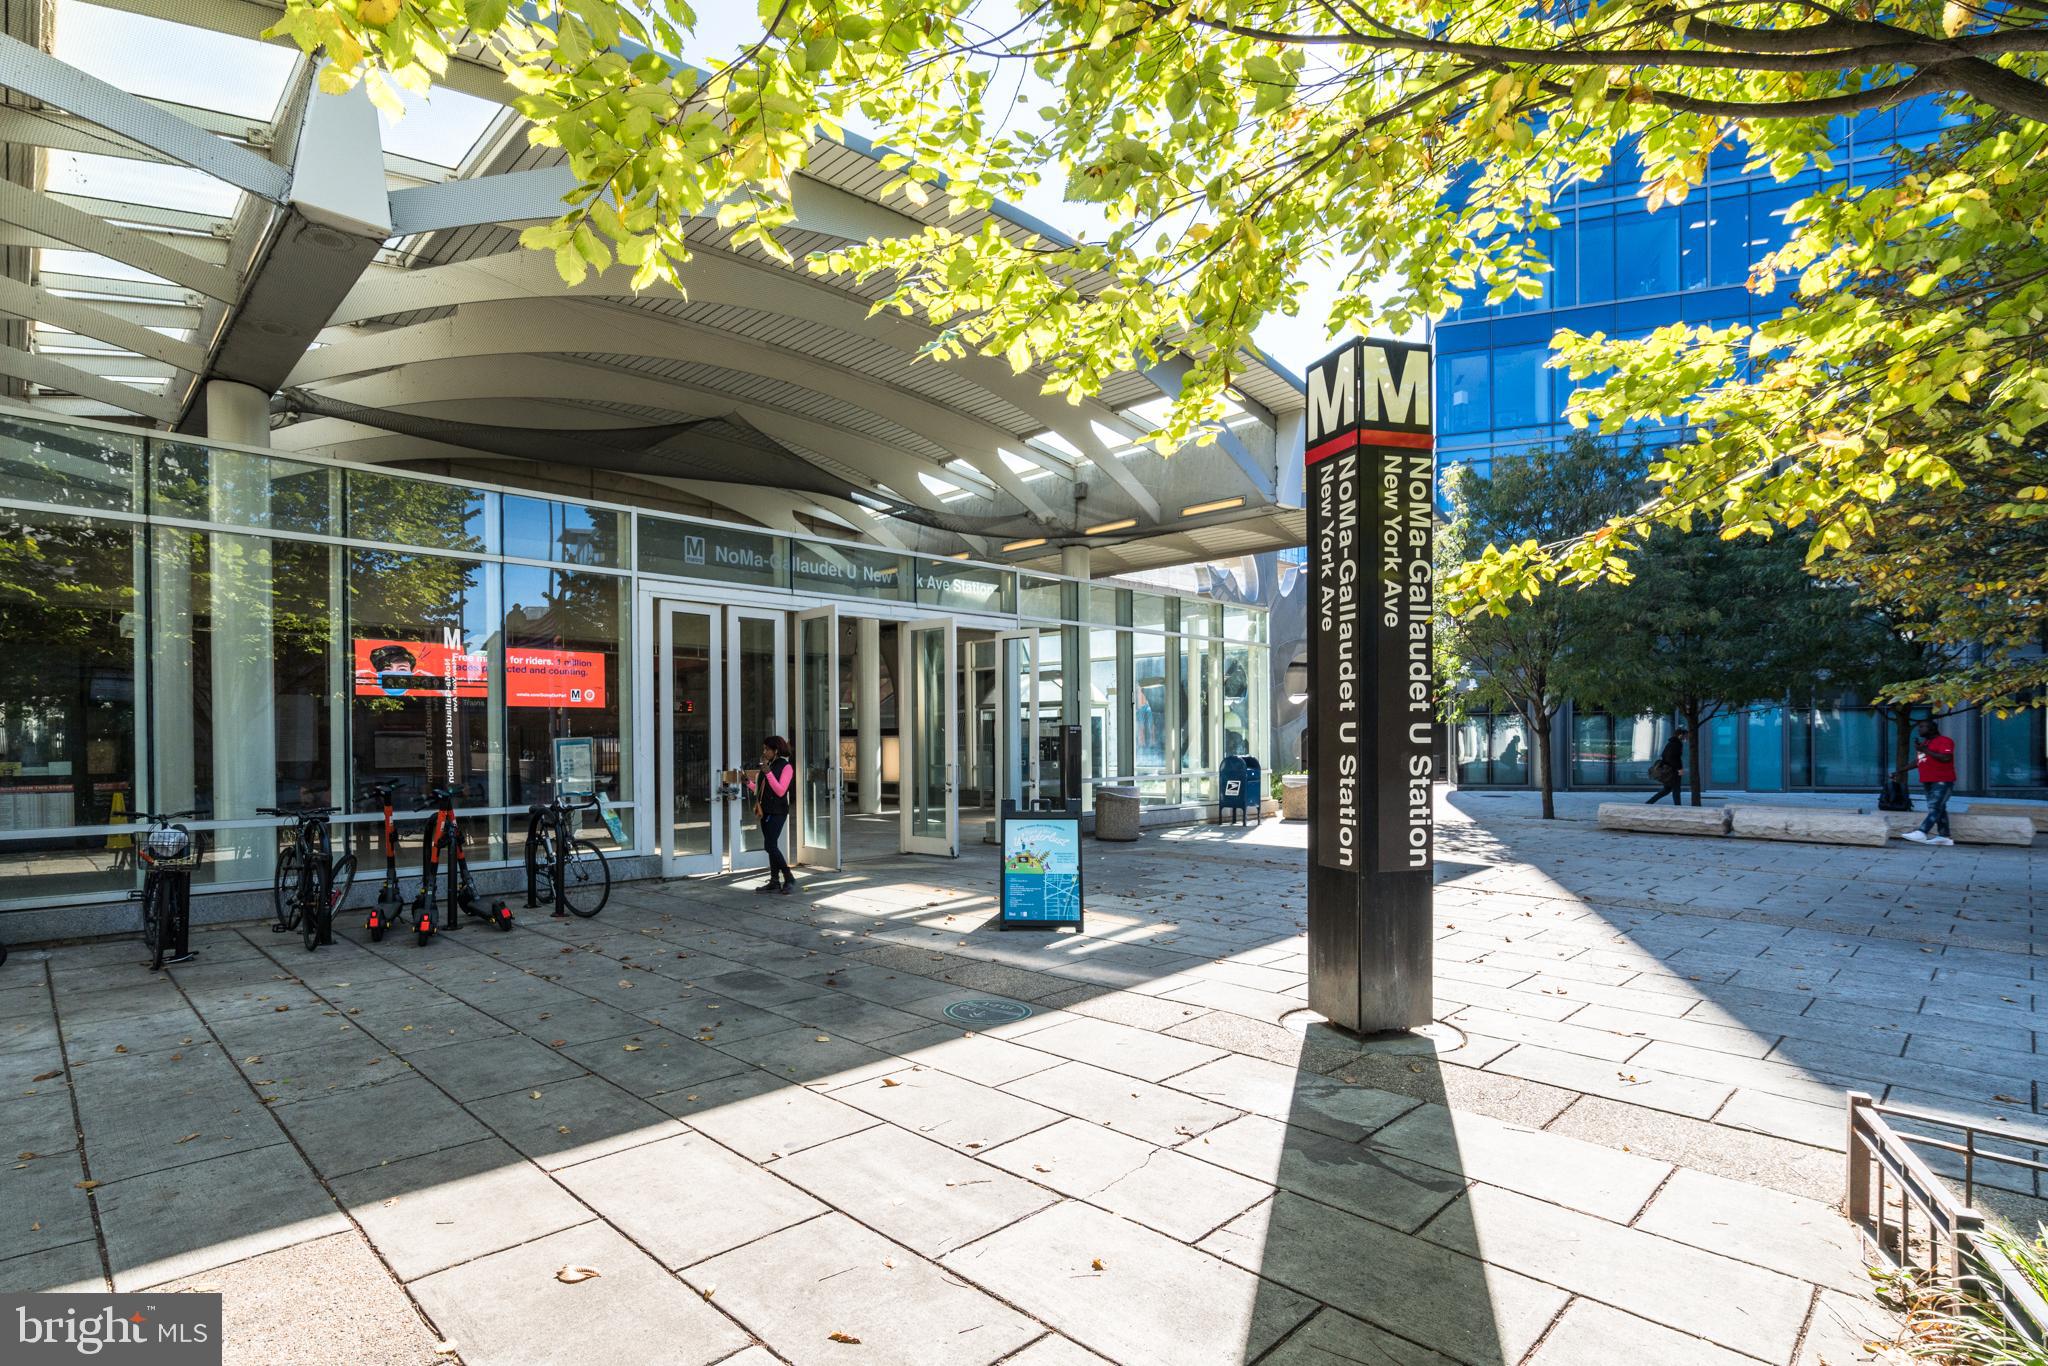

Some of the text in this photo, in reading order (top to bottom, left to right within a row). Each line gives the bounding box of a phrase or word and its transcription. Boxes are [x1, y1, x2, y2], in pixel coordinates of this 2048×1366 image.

[1308, 346, 1355, 443] M
[1363, 345, 1430, 426] M
[687, 536, 703, 557] M
[847, 564, 857, 580] U
[863, 566, 891, 584] New
[926, 575, 950, 592] Ave
[952, 578, 996, 595] Station
[1320, 463, 1335, 632] New York Ave
[1383, 455, 1403, 628] New York Ave
[509, 655, 524, 665] for
[525, 656, 554, 666] riders.
[564, 658, 592, 667] million
[529, 666, 546, 674] and
[548, 667, 588, 678] counting.
[1338, 454, 1357, 867] NoMa-Gallaudet U Station
[1408, 456, 1433, 867] NoMa-Gallaudet U Station
